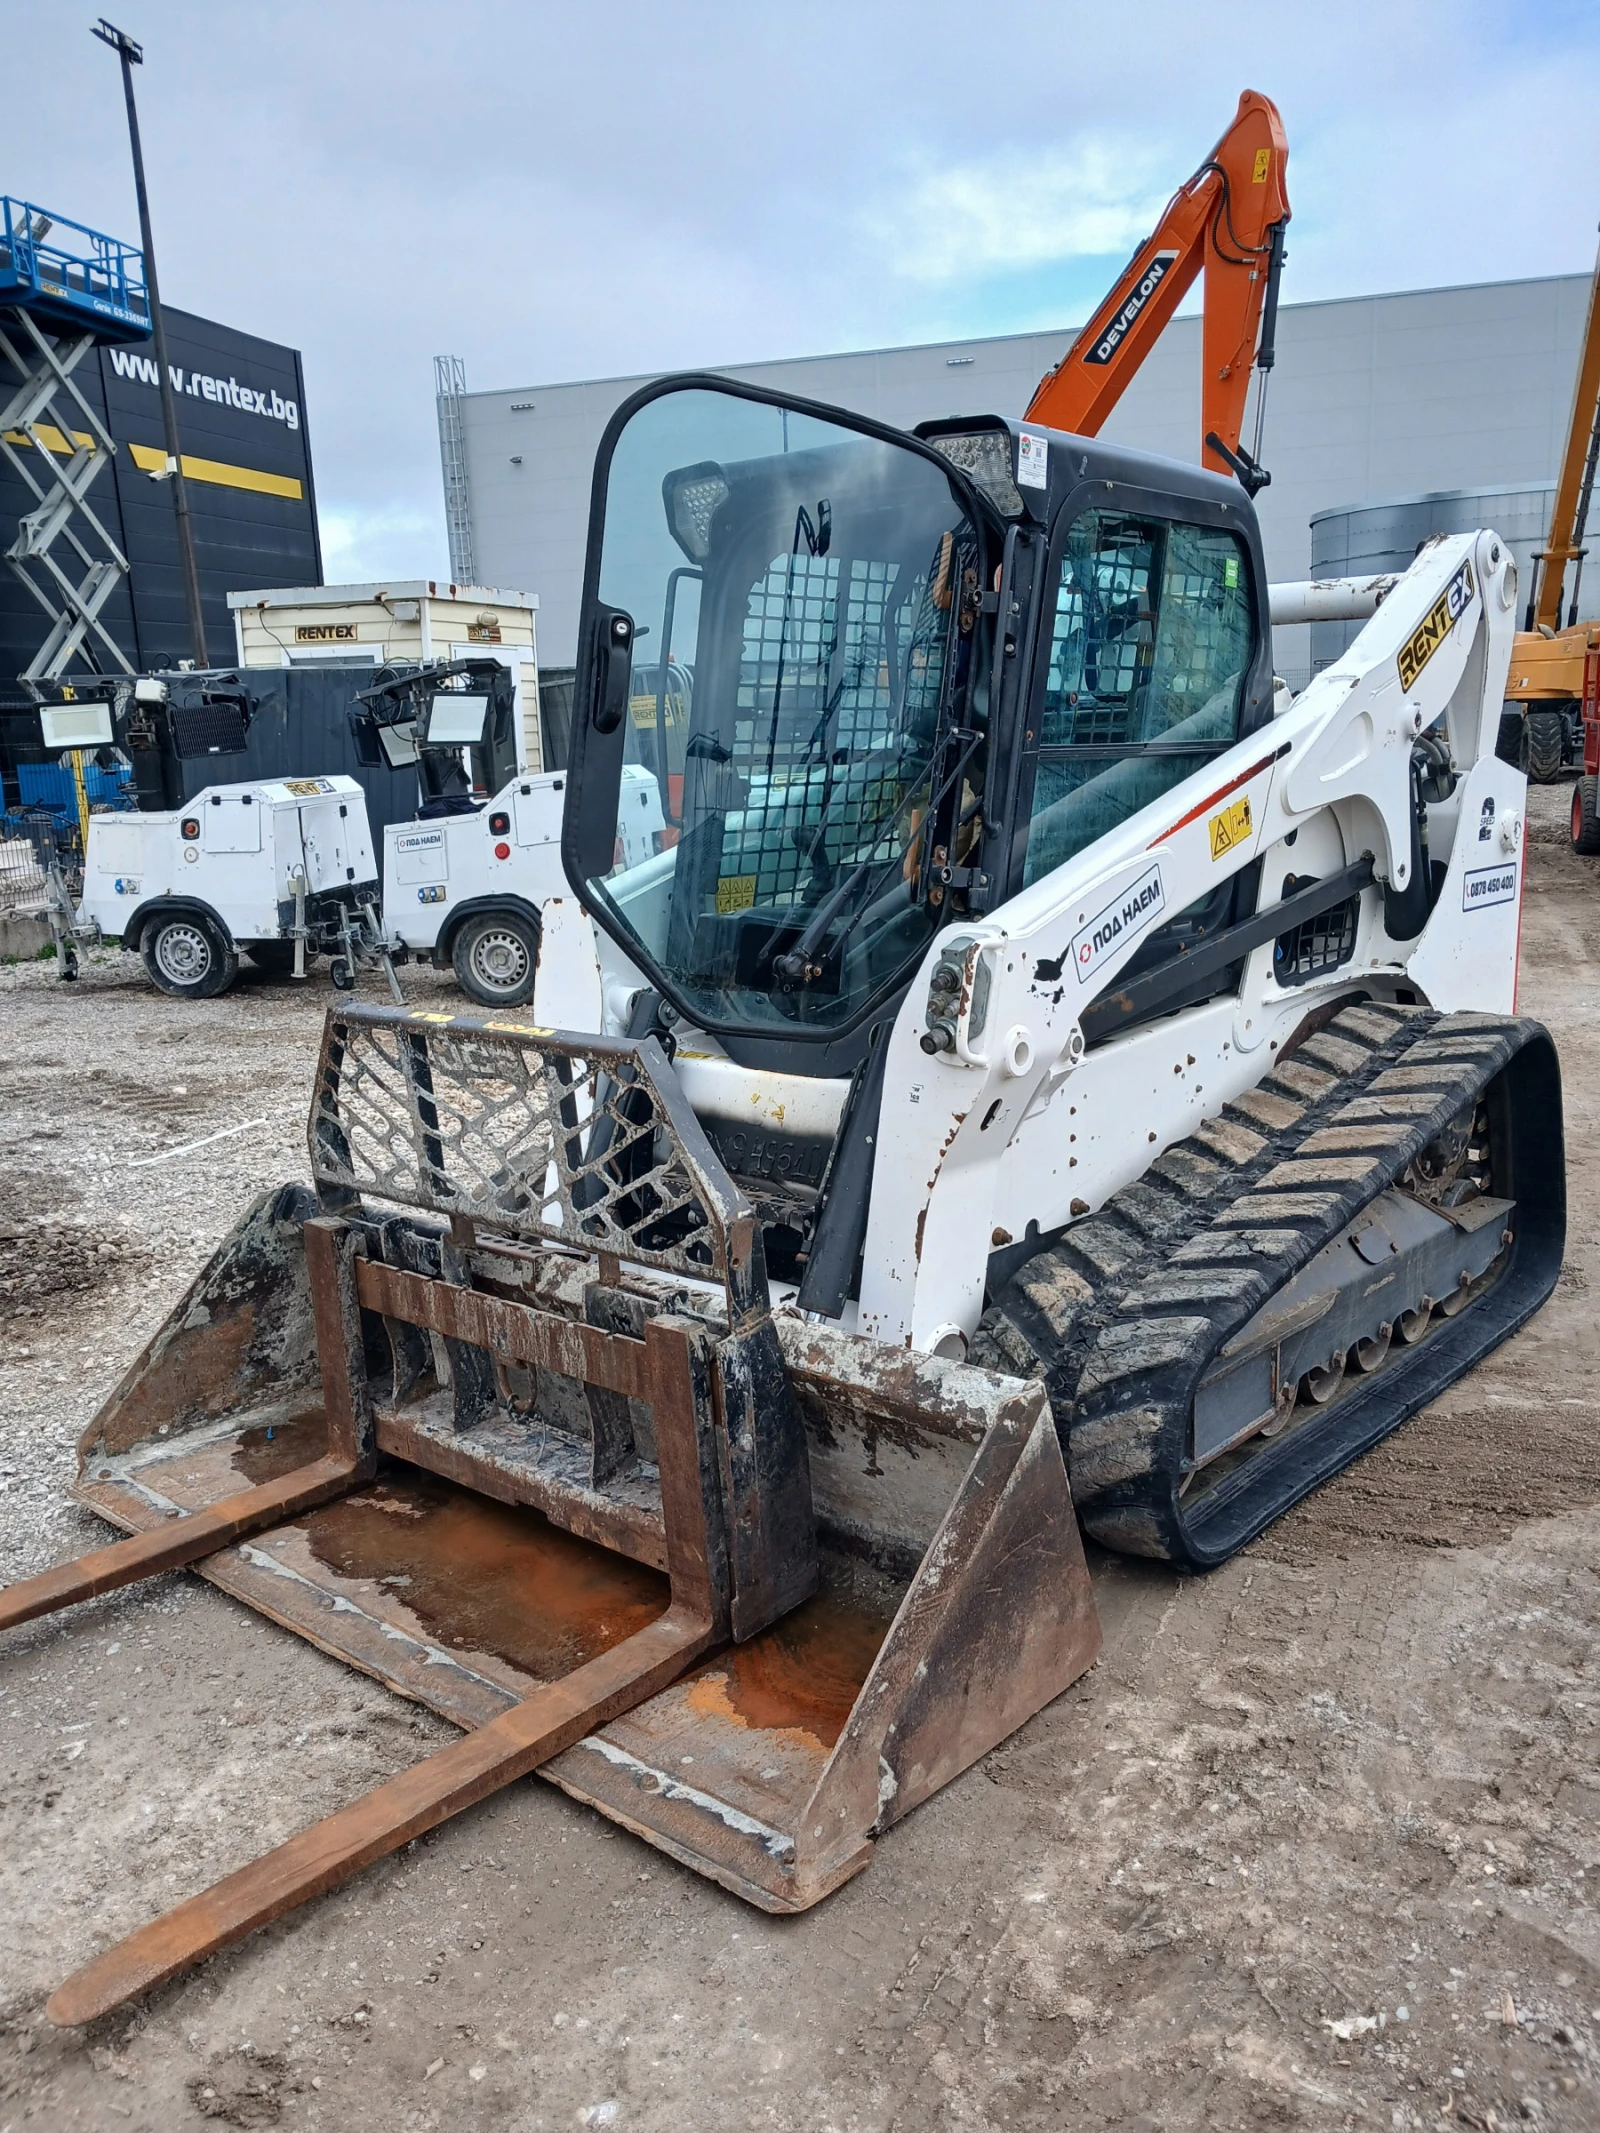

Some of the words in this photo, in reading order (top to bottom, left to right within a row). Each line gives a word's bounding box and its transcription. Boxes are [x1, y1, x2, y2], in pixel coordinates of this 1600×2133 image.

[1096, 263, 1165, 360] DEVELON
[297, 624, 354, 640] RENTEX
[1399, 566, 1472, 686] RENTEX
[1480, 816, 1496, 826] SPEED
[406, 838, 420, 847] ПОД
[420, 835, 441, 845] НАЕМ
[1470, 880, 1486, 898] 0878
[1487, 877, 1500, 893] 450
[1501, 875, 1514, 890] 400
[1092, 916, 1122, 954] ПОД
[1122, 879, 1161, 927] НАЕМ
